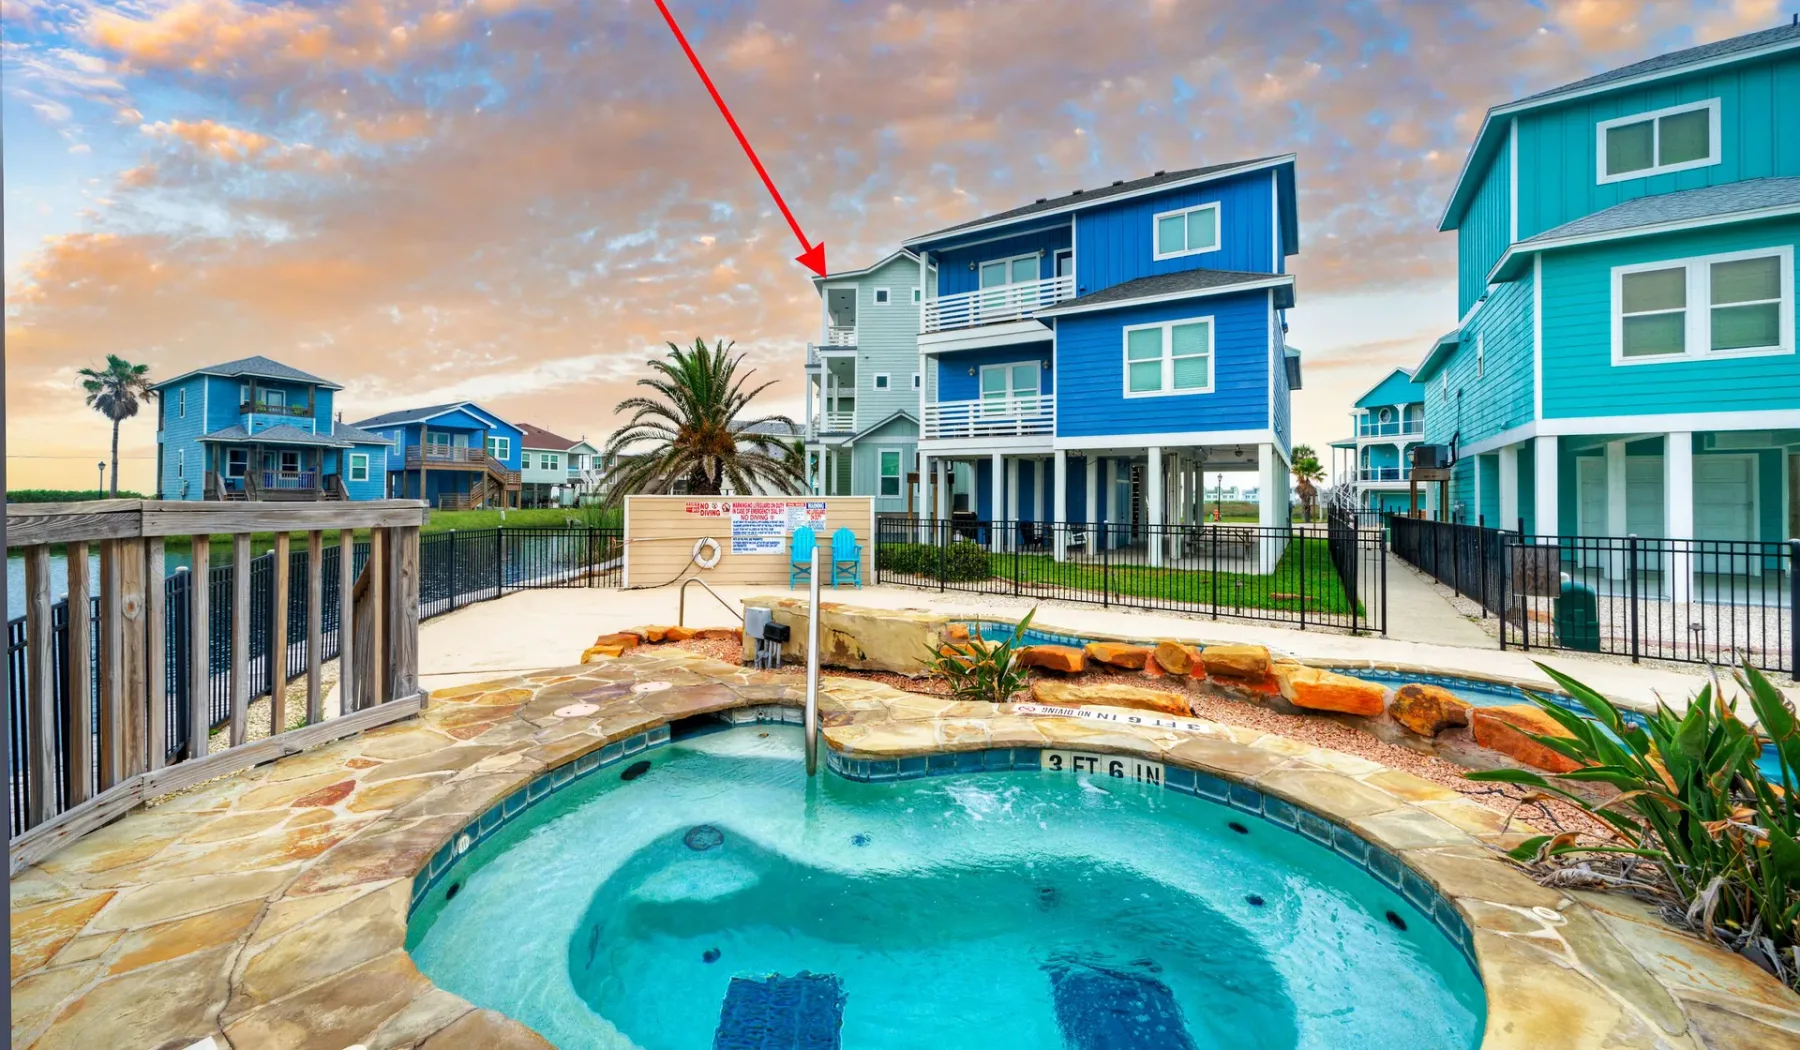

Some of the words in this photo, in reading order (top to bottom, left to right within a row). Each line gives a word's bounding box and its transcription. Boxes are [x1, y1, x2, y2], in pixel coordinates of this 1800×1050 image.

[1041, 707, 1073, 716] DIVING
[1154, 719, 1177, 728] FT
[1049, 755, 1063, 771] 3
[1073, 756, 1098, 774] FT
[1109, 761, 1124, 778] 6
[1137, 764, 1160, 786] IN
